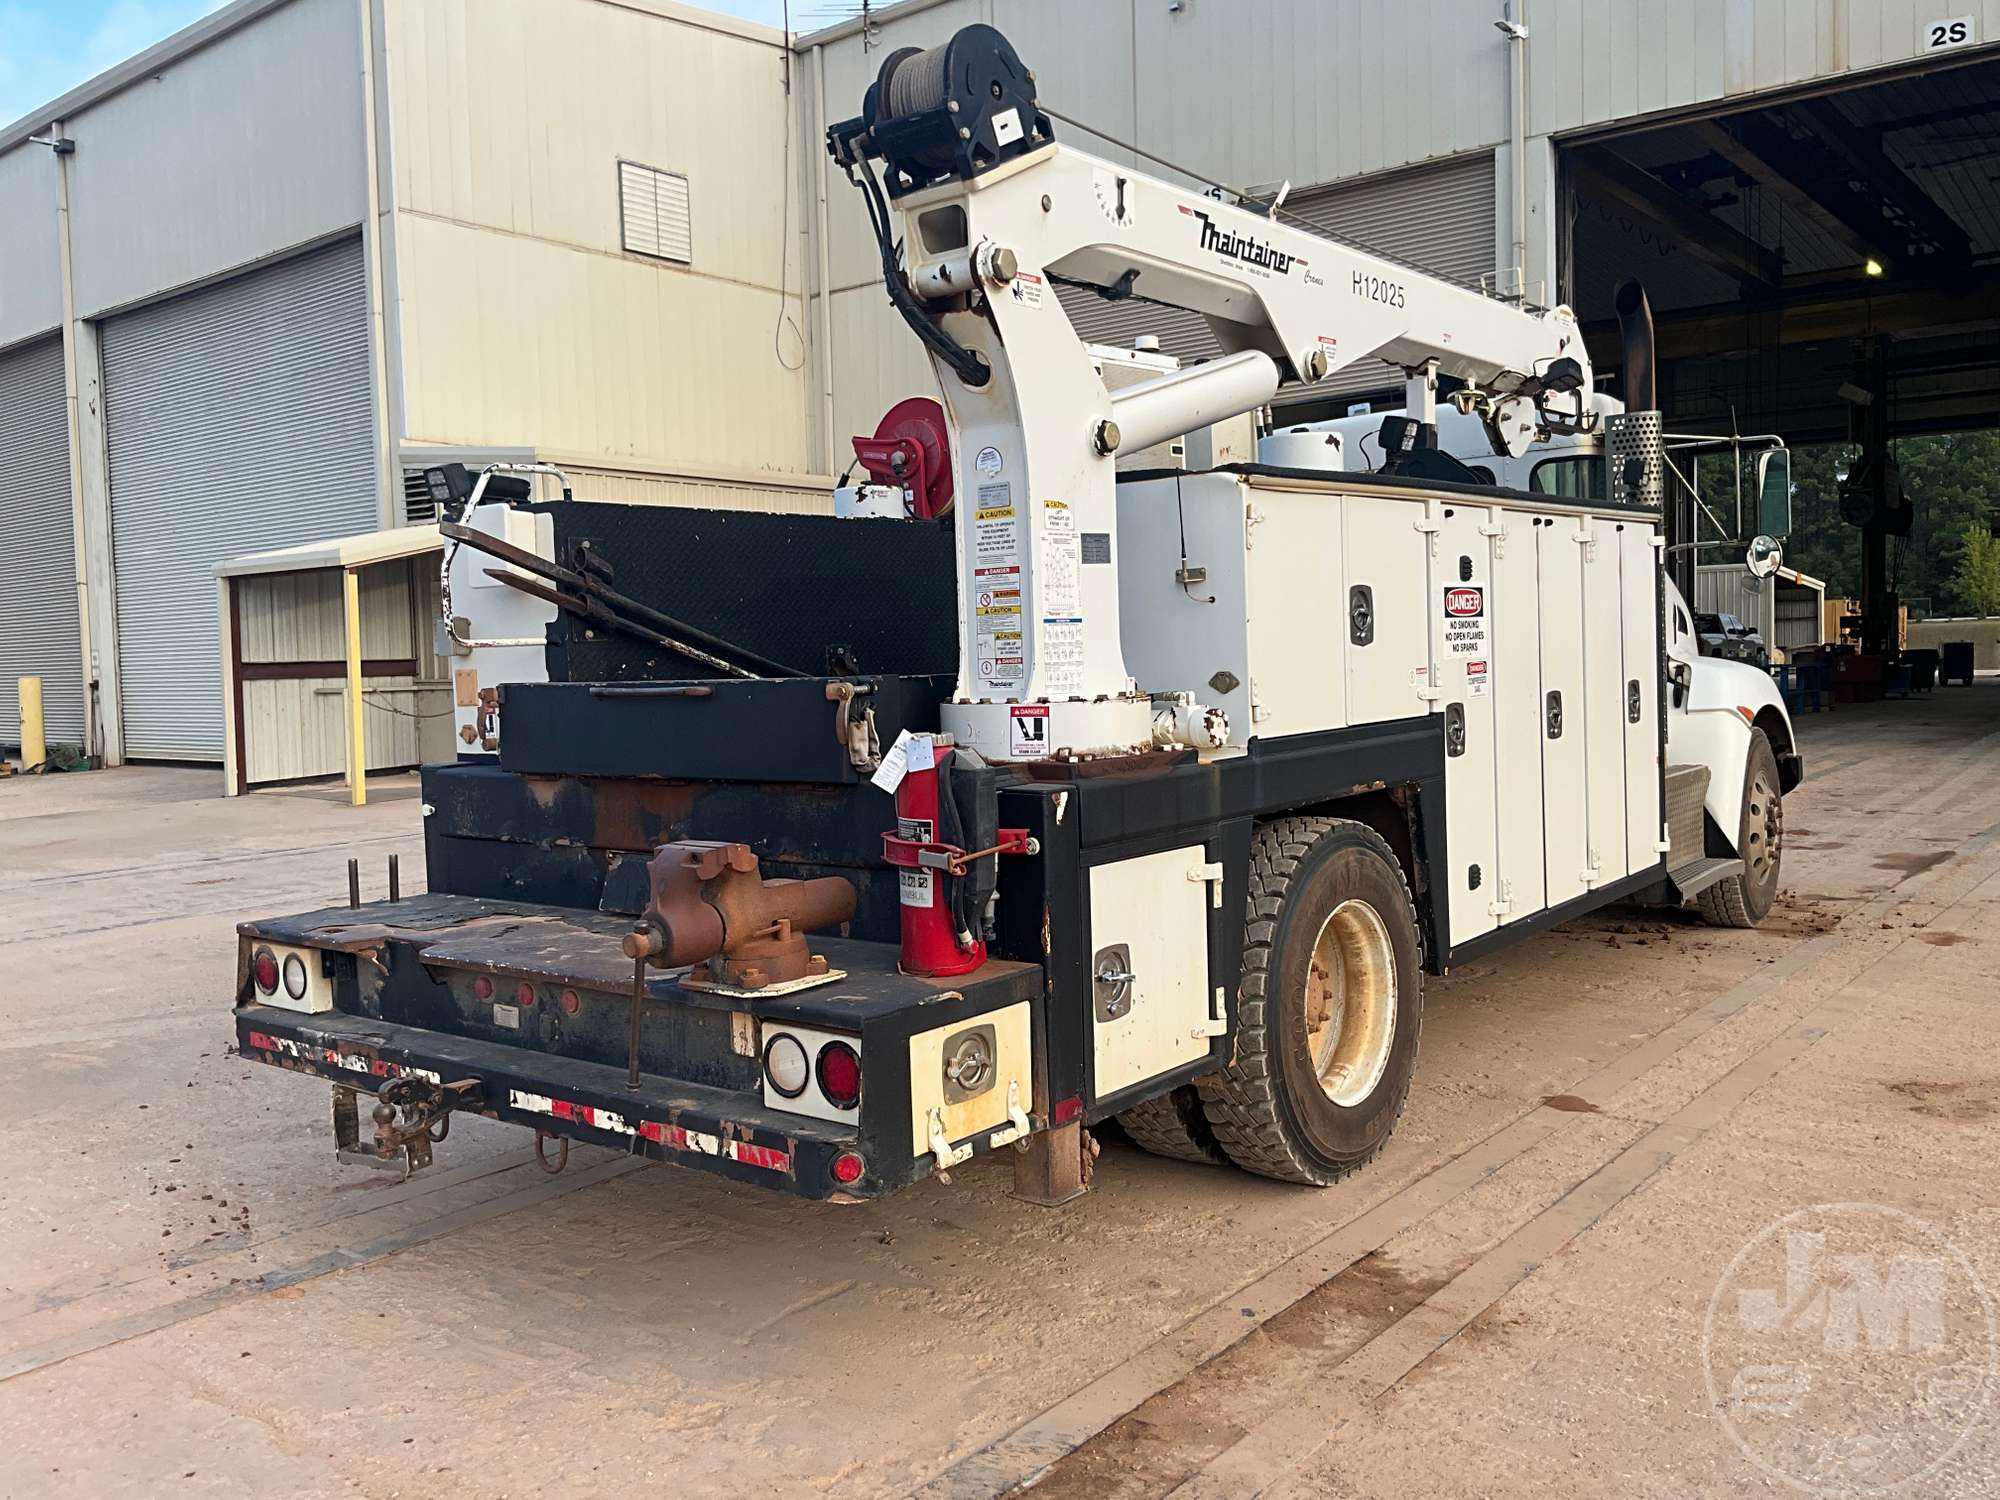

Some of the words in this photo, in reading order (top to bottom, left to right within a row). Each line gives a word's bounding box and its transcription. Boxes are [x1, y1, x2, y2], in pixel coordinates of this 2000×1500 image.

[1931, 22, 1966, 47] 2S
[1193, 210, 1296, 275] Maintainer
[1352, 270, 1405, 309] H12025
[985, 509, 1012, 518] CAUTION
[1448, 594, 1481, 610] DANGER
[1450, 621, 1457, 630] NO
[1458, 620, 1479, 629] SMOKING
[1445, 633, 1452, 641] NO
[1453, 632, 1466, 641] OPEN
[1466, 631, 1484, 640] FLAMES
[1452, 643, 1459, 652] NO
[1460, 642, 1478, 652] SPARKS
